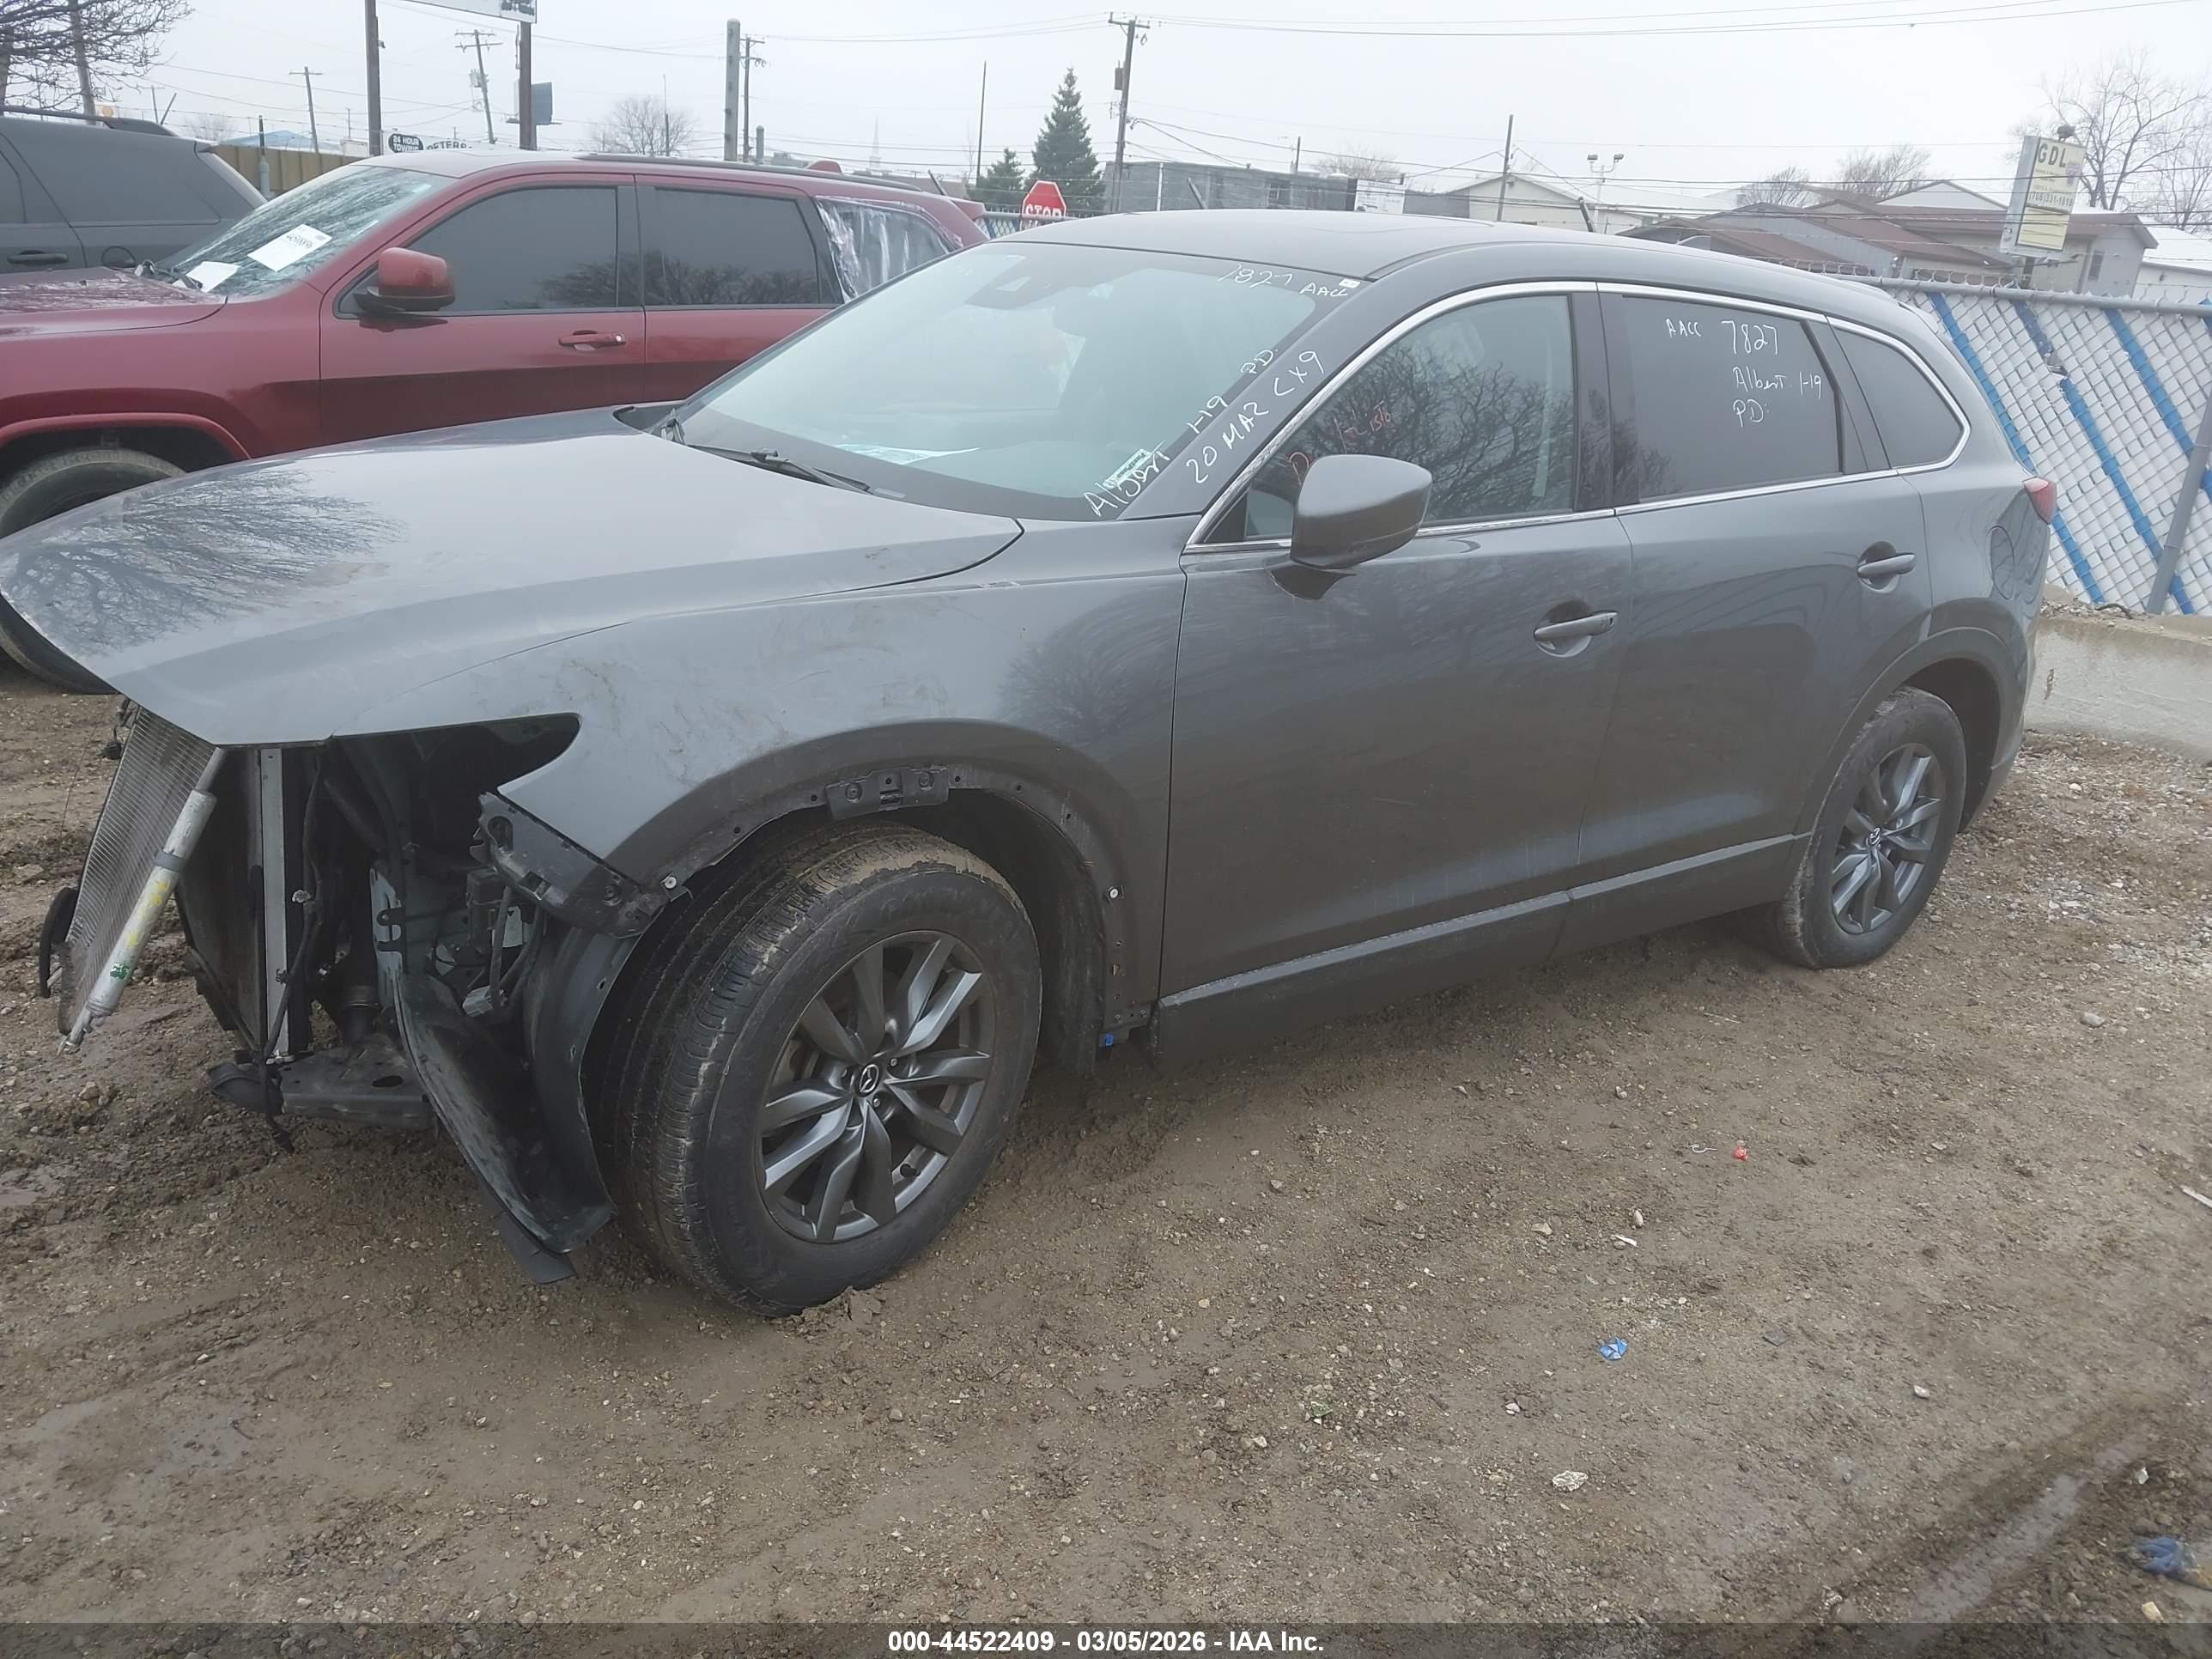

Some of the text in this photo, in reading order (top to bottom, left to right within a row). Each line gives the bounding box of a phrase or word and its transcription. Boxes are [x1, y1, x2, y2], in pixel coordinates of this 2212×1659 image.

[402, 137, 419, 145] HOUR
[2038, 143, 2066, 167] GDL
[1721, 319, 1778, 356] 7827
[1799, 371, 1822, 399] 1-19
[1186, 395, 1229, 434] 1-19
[1186, 446, 1218, 492] 20
